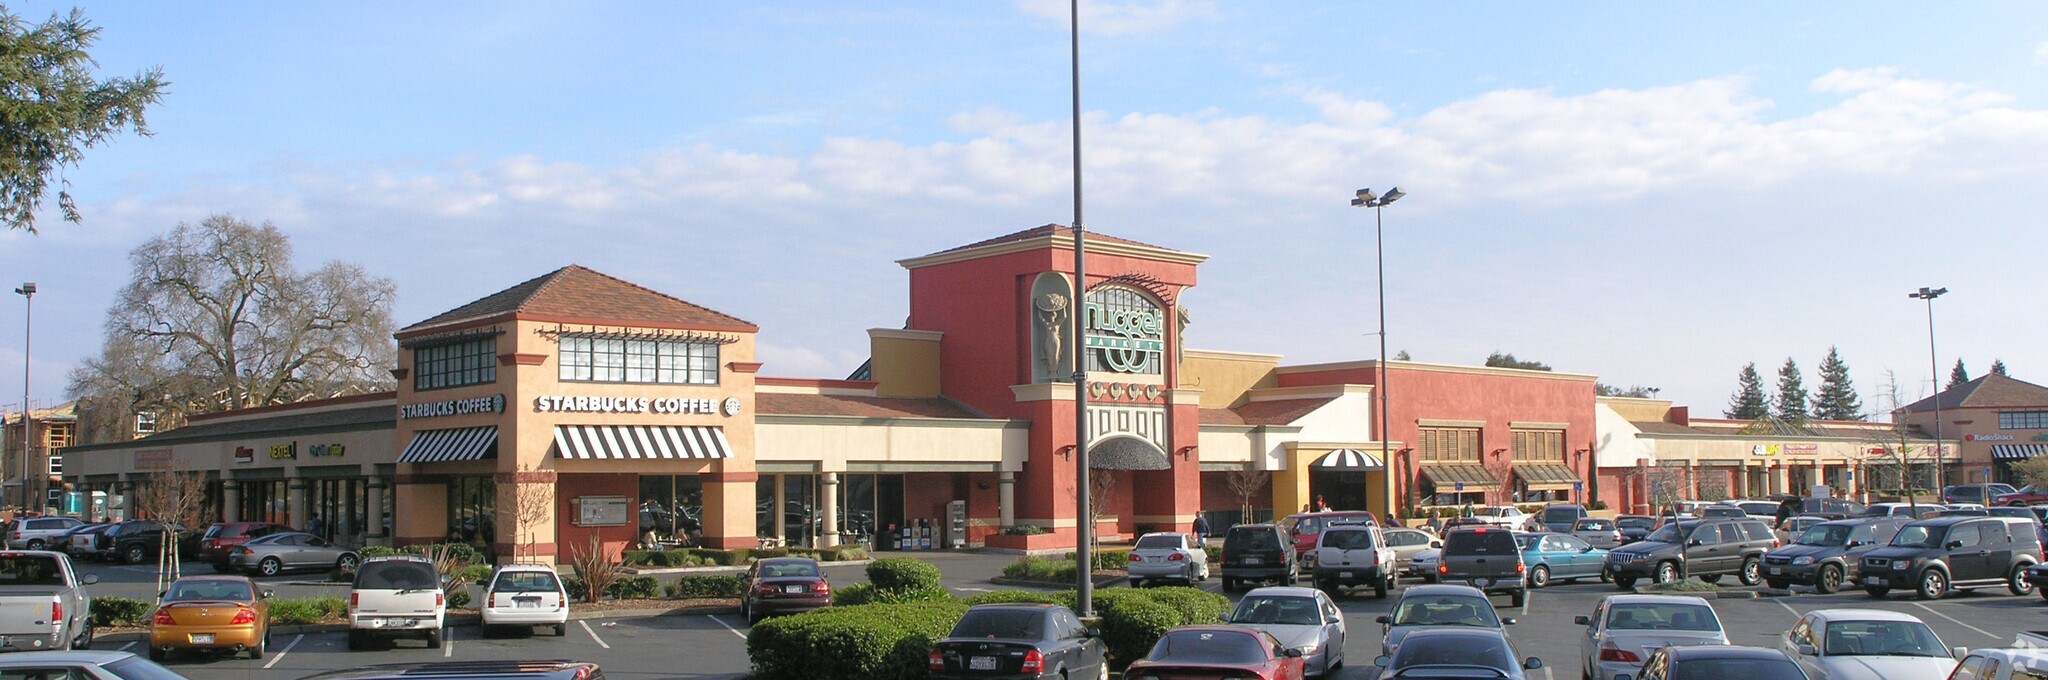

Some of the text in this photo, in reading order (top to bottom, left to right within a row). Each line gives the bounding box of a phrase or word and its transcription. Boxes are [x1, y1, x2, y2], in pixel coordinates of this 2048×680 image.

[1086, 338, 1164, 350] MARKETS
[401, 397, 492, 419] STARBUCKS COFFEE
[539, 395, 719, 413] STARBUCKS COFFEE
[1974, 433, 2014, 441] RadioShack
[269, 444, 294, 459] NEXTEL
